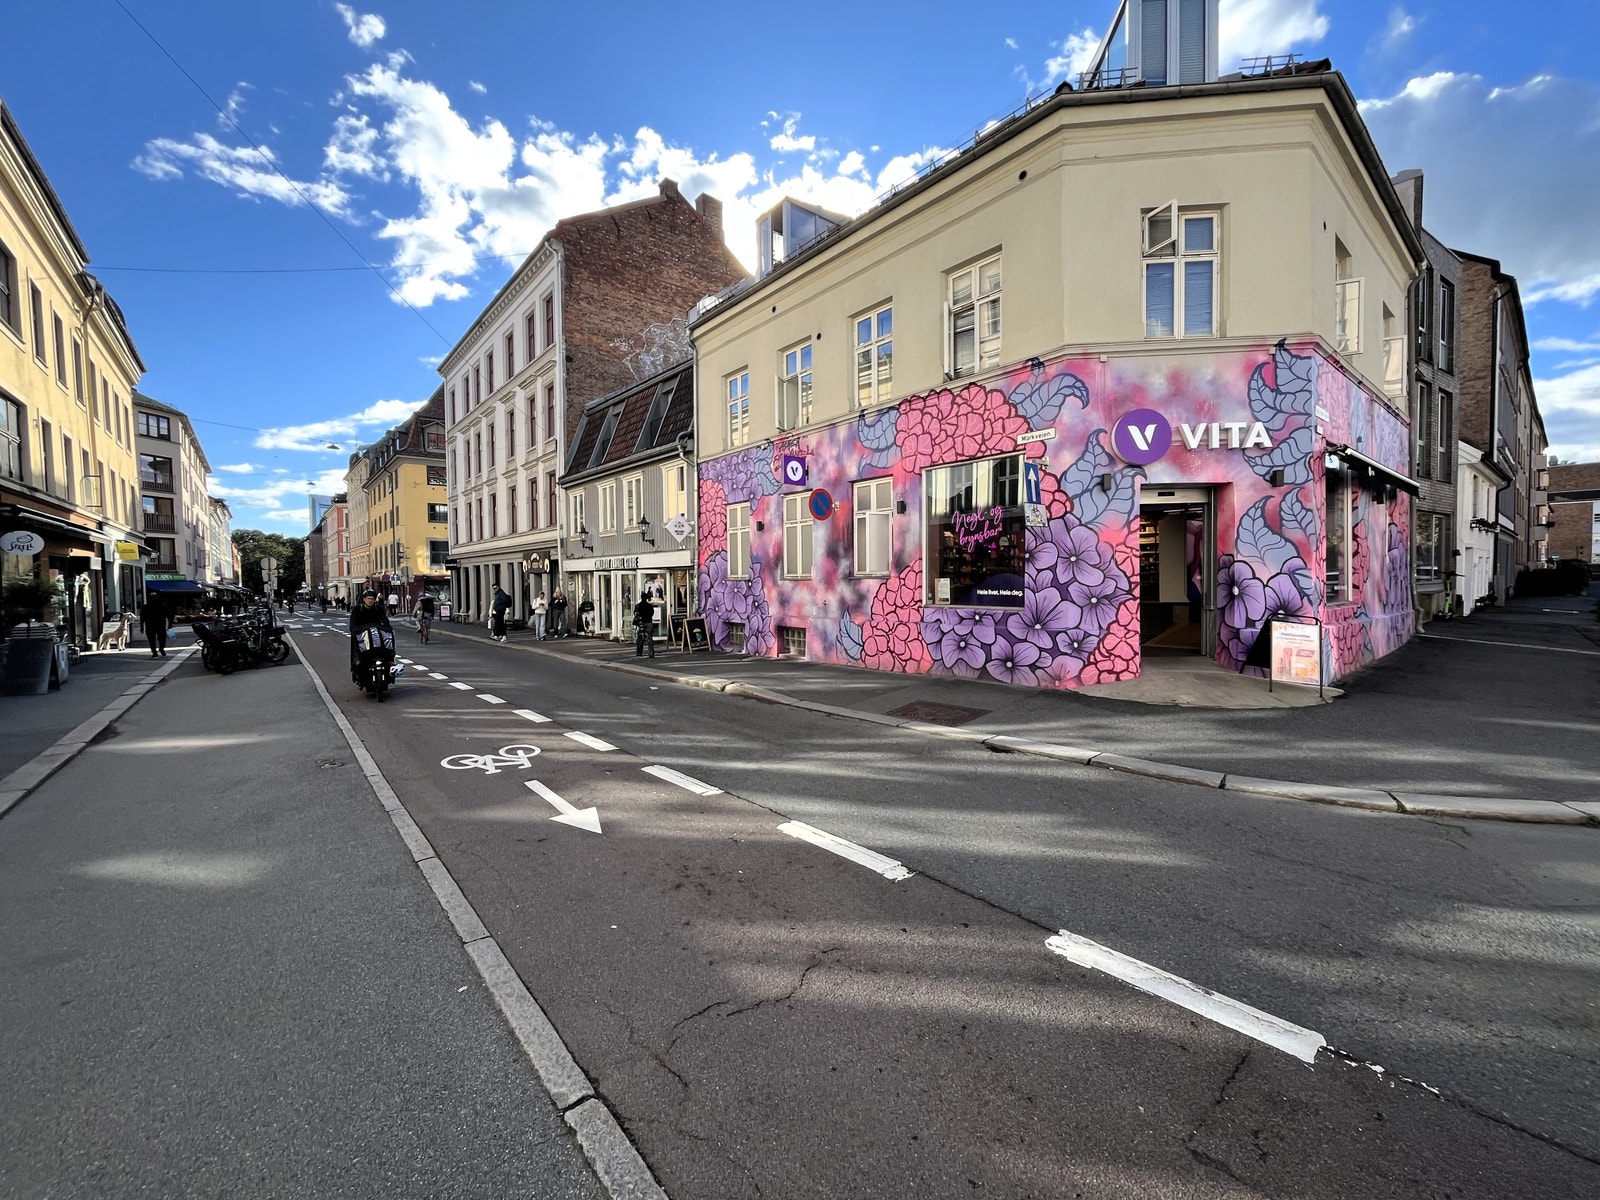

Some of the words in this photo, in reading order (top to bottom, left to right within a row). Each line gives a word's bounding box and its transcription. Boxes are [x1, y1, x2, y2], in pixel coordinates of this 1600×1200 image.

[1021, 431, 1051, 442] Markveien
[1178, 422, 1273, 449] VITA
[990, 505, 1003, 525] og
[959, 520, 999, 553] brynsbar
